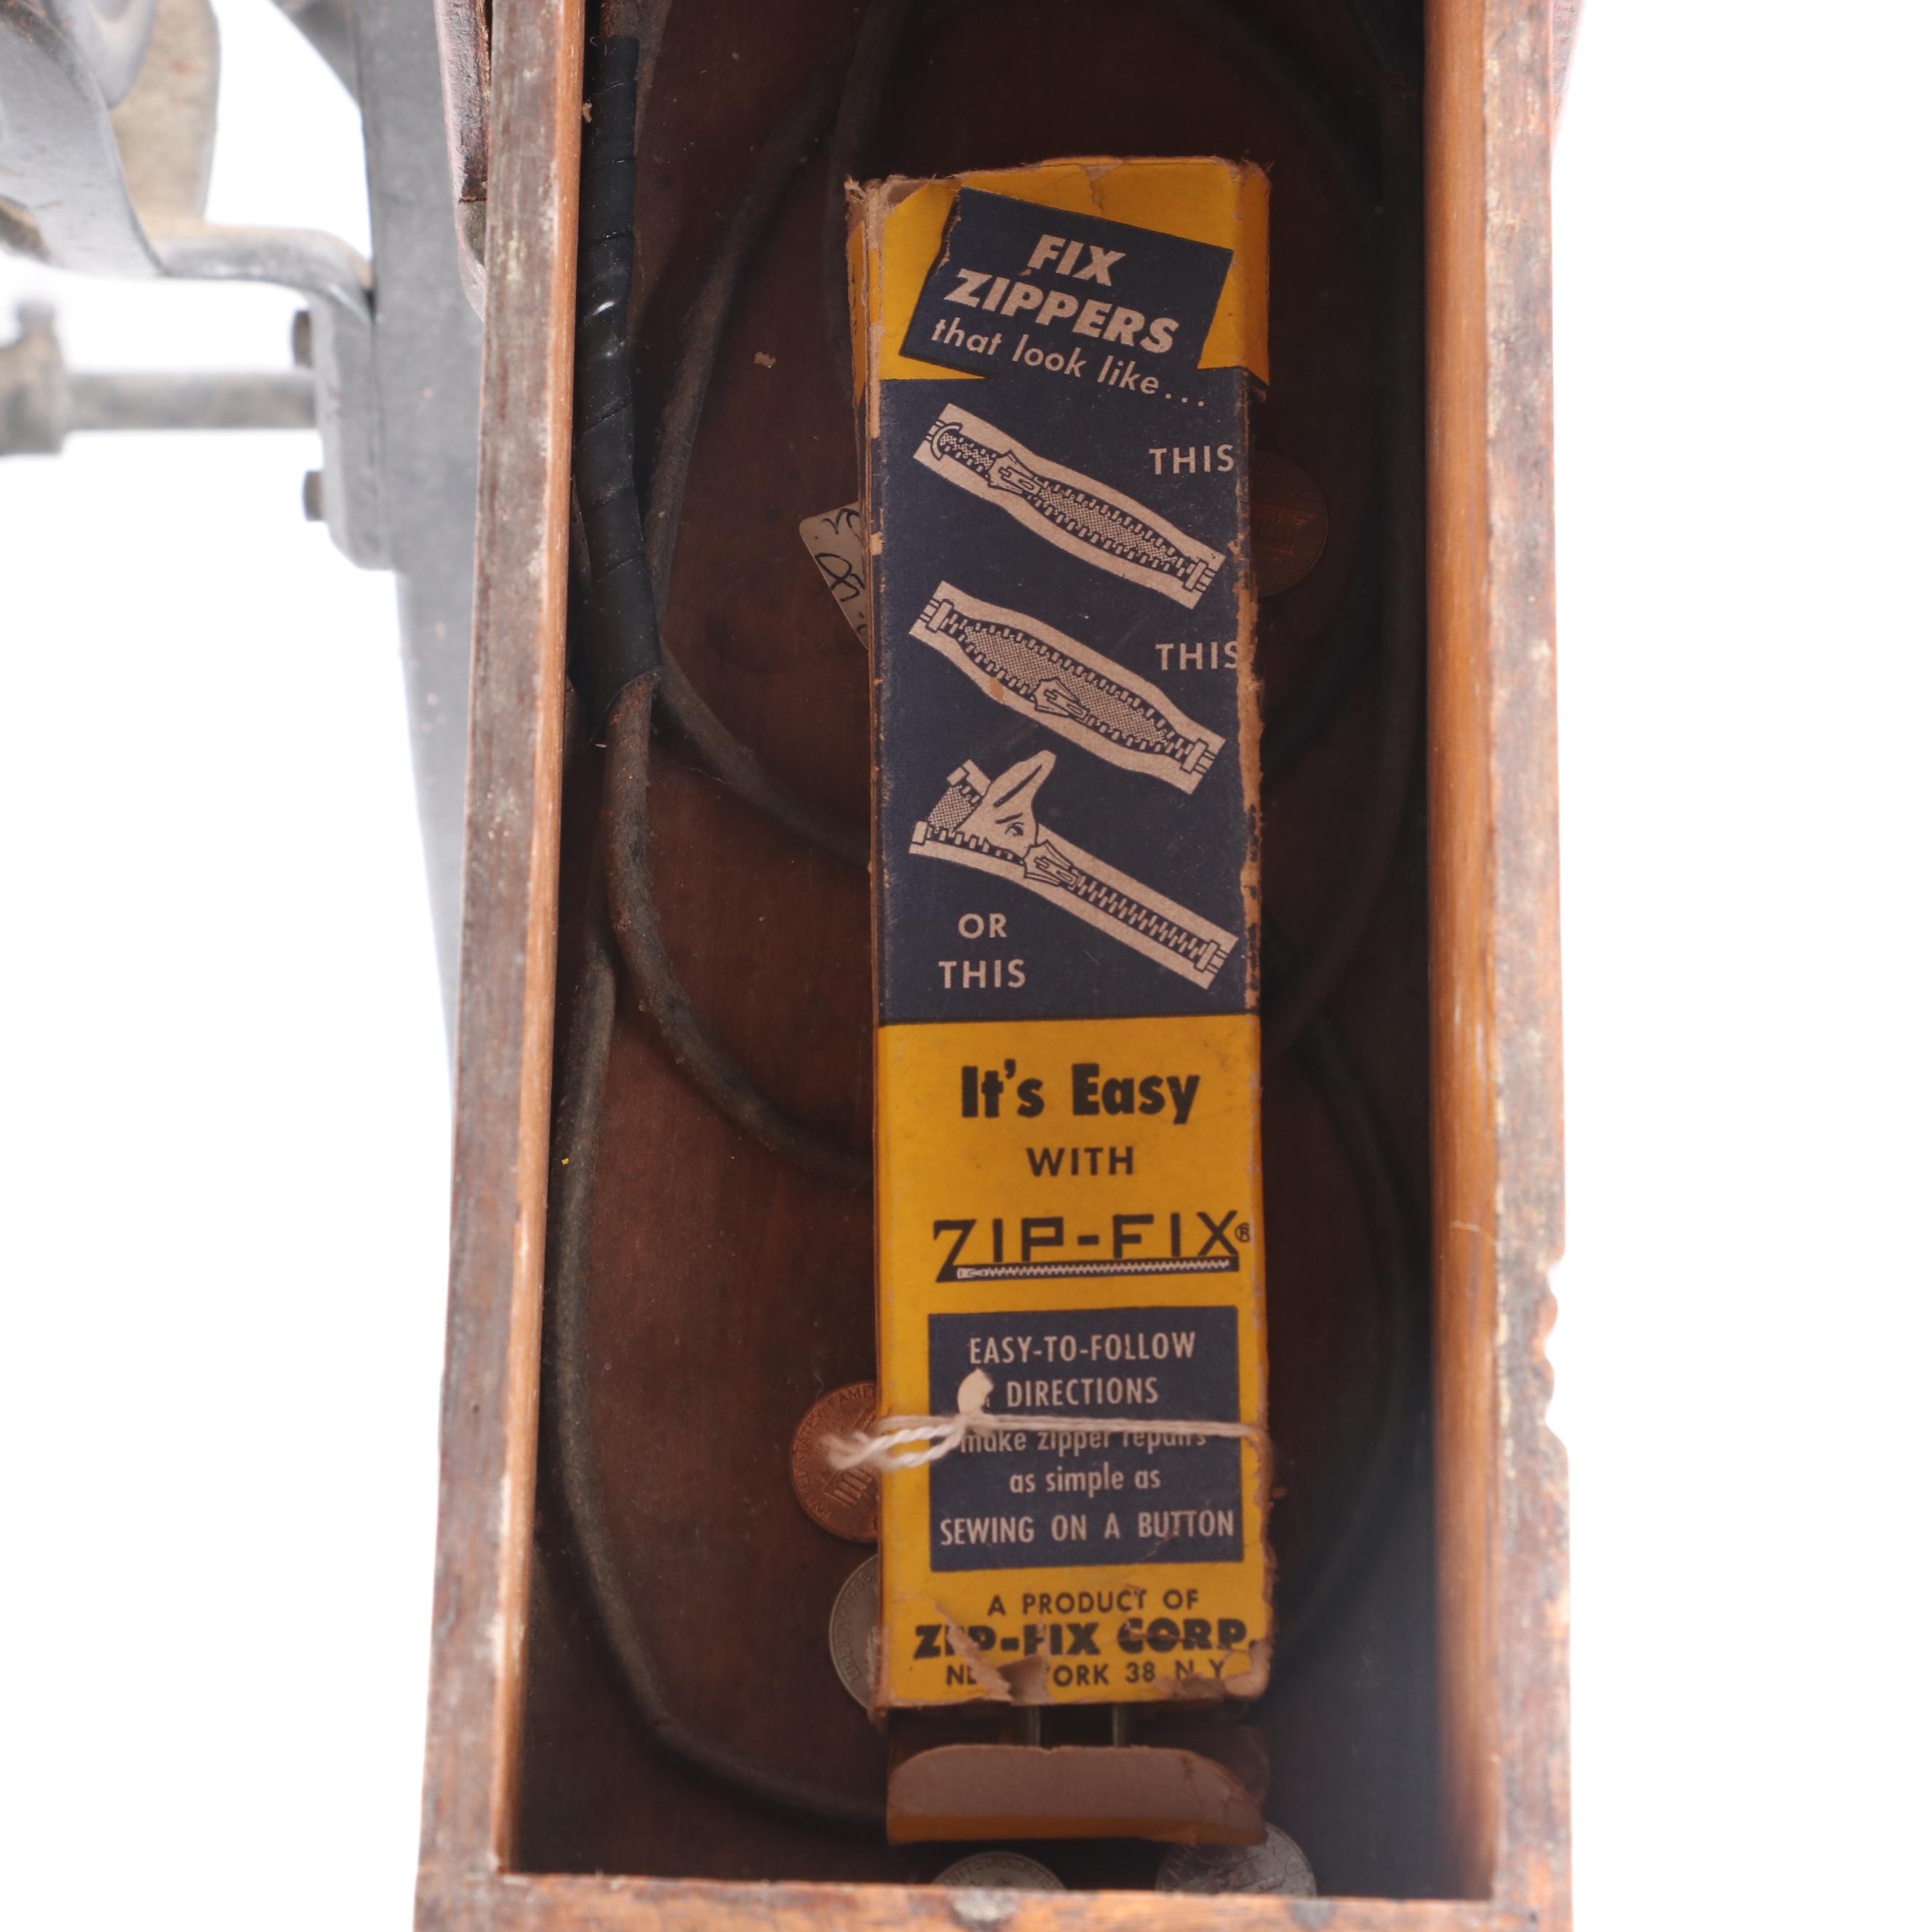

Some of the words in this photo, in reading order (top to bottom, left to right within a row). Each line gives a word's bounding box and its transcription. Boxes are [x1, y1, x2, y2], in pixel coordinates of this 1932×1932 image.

[1028, 233, 1125, 287] FIX
[943, 267, 1180, 354] ZIPPERS
[930, 317, 1002, 356] that
[1012, 334, 1082, 378] look
[1149, 444, 1235, 475] THIS
[1155, 640, 1238, 671] THIS
[958, 912, 1007, 939] OR
[938, 959, 1027, 989] THIS
[960, 1058, 1045, 1119] It's
[1071, 1062, 1201, 1125] Easy
[1026, 1146, 1135, 1177] WITH
[969, 1331, 1197, 1365] EASY-TO-FOLLOW
[1007, 1377, 1159, 1408] DIRECTIONS
[959, 1430, 1026, 1453] make
[1037, 1430, 1109, 1458] zipper
[1009, 1473, 1037, 1493] as
[1045, 1461, 1125, 1499] simple
[1133, 1469, 1162, 1489] as
[939, 1515, 1035, 1546] SEWING
[1051, 1514, 1087, 1543] ON
[1104, 1513, 1121, 1539] A
[1138, 1509, 1235, 1539] BUTTON
[986, 1594, 1007, 1617] A
[1021, 1589, 1146, 1616] PRODUCT
[1162, 1588, 1199, 1611] OF
[1046, 1662, 1109, 1688] ORK
[1125, 1661, 1156, 1687] 38
